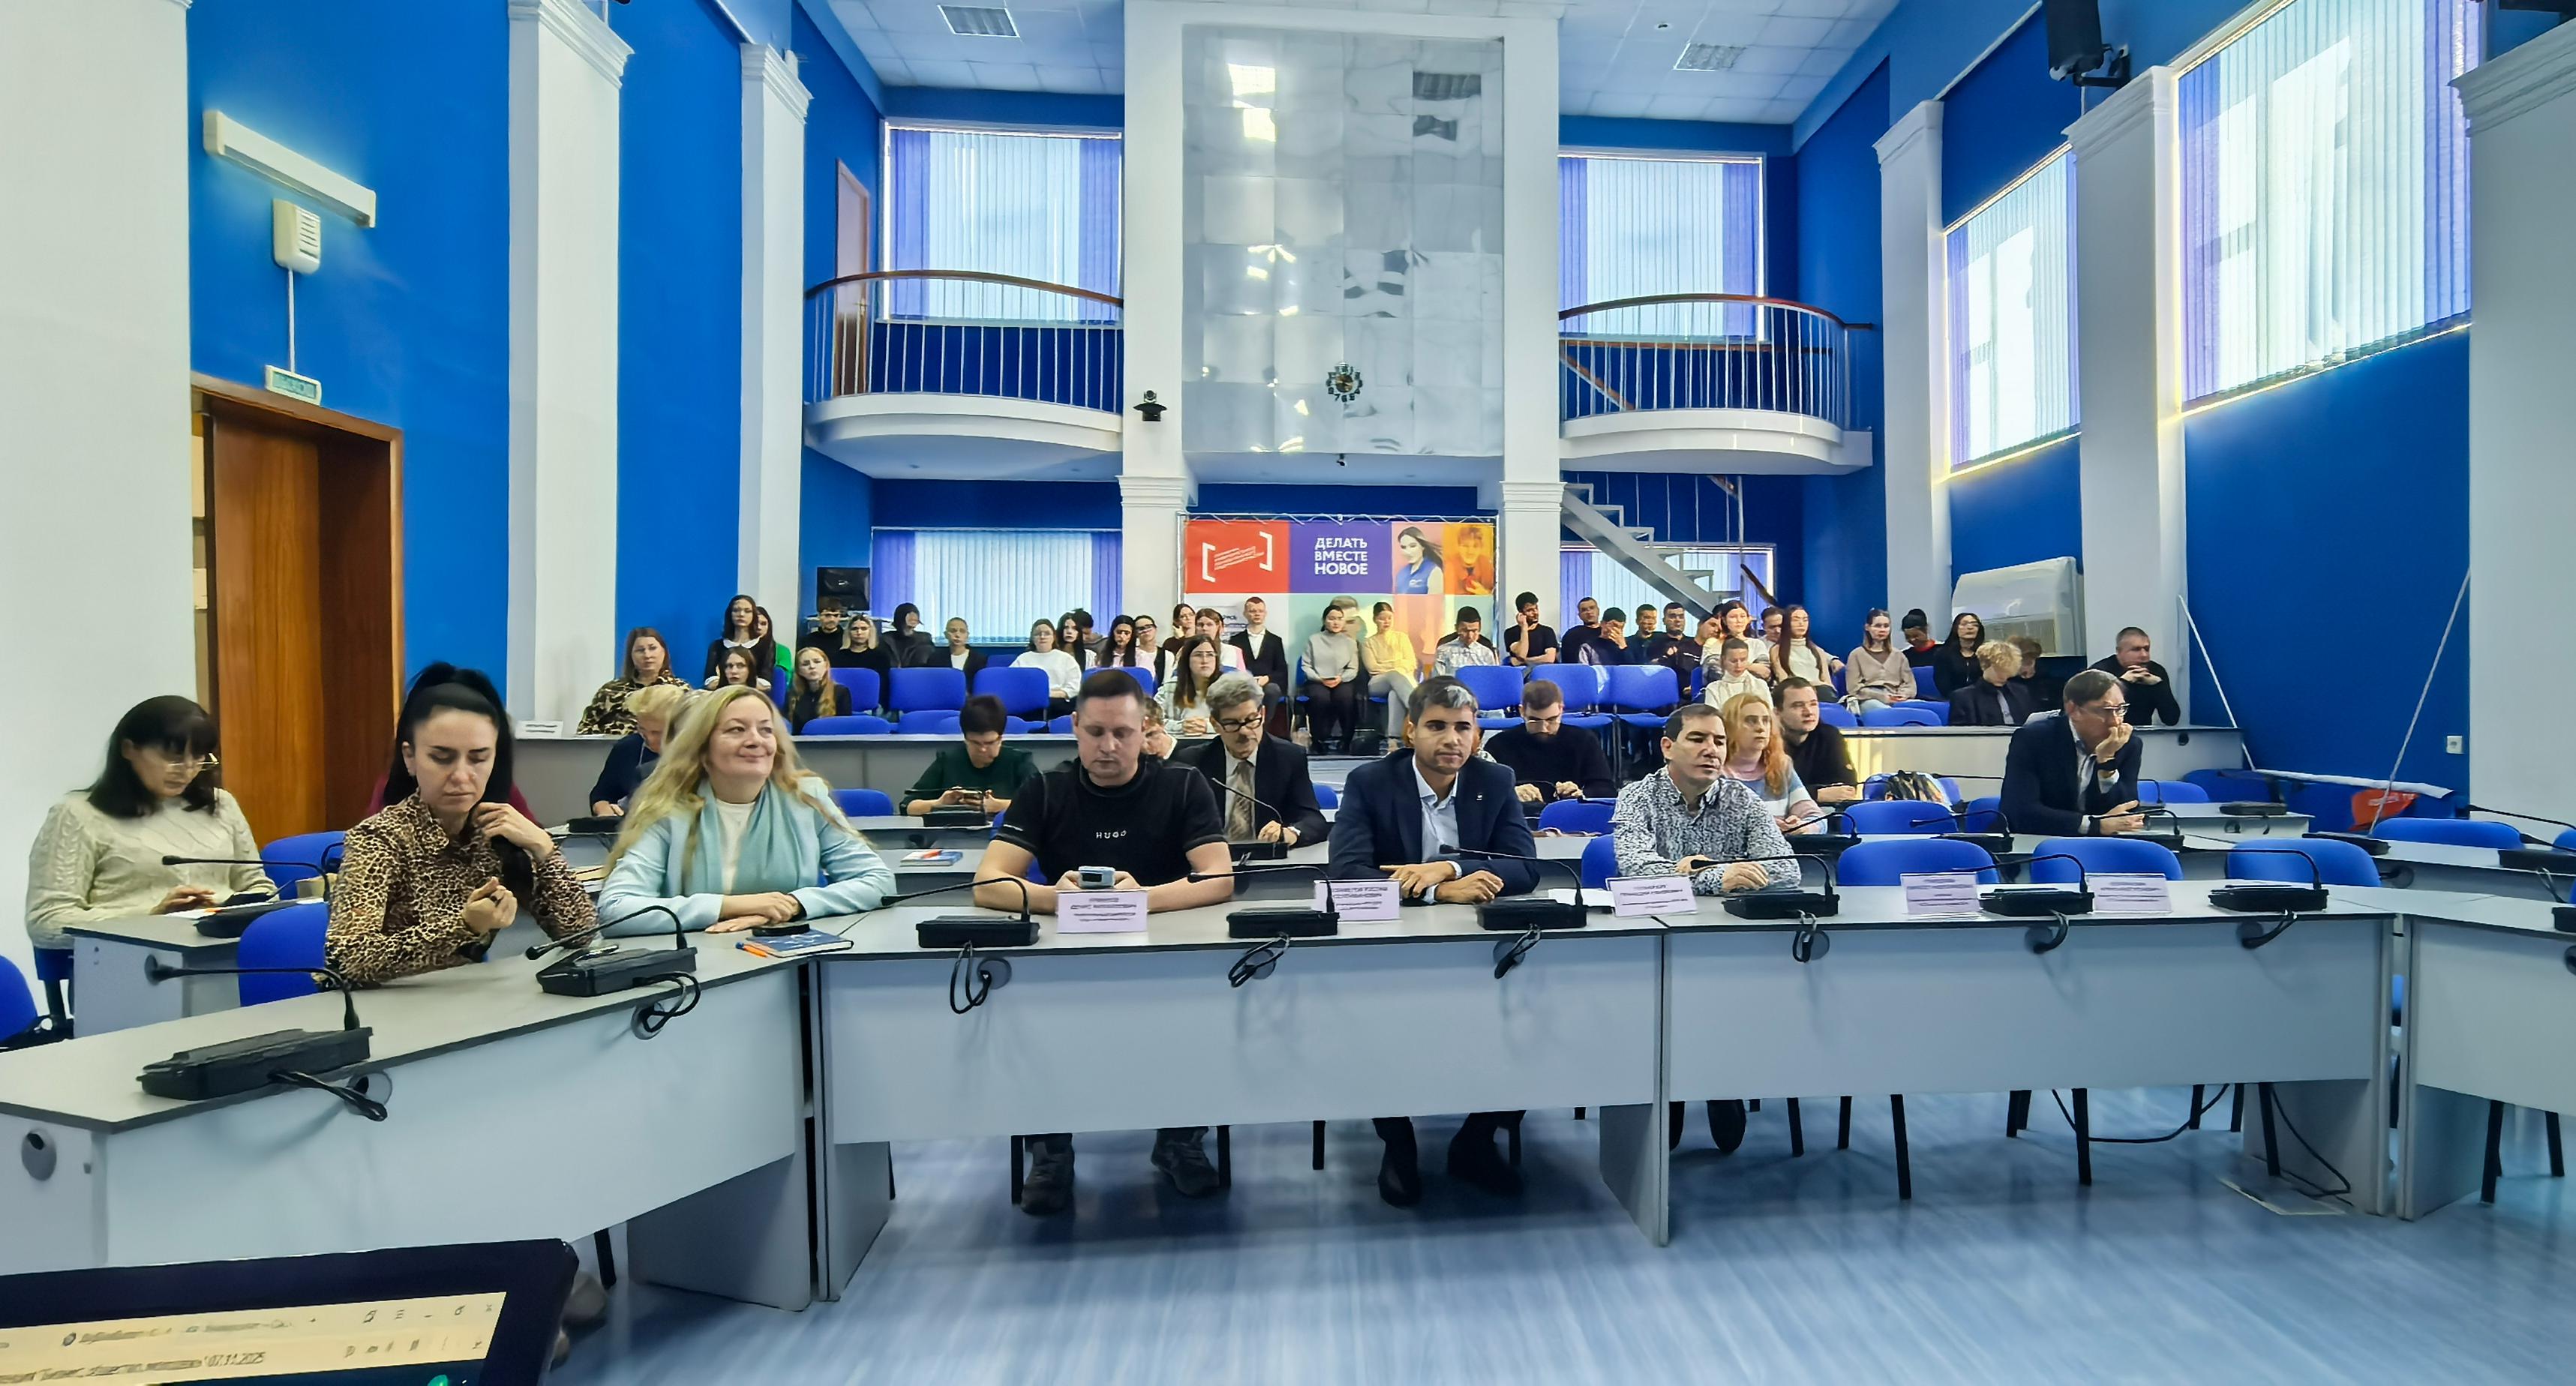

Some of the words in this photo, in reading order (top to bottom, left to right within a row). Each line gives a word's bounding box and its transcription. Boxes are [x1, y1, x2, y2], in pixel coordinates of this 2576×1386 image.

[1314, 537, 1368, 550] ДЕЛАТЬ
[1314, 550, 1368, 561] ВМЕСТЕ
[1314, 562, 1368, 575] НОВОЕ
[1096, 830, 1127, 839] HUGO
